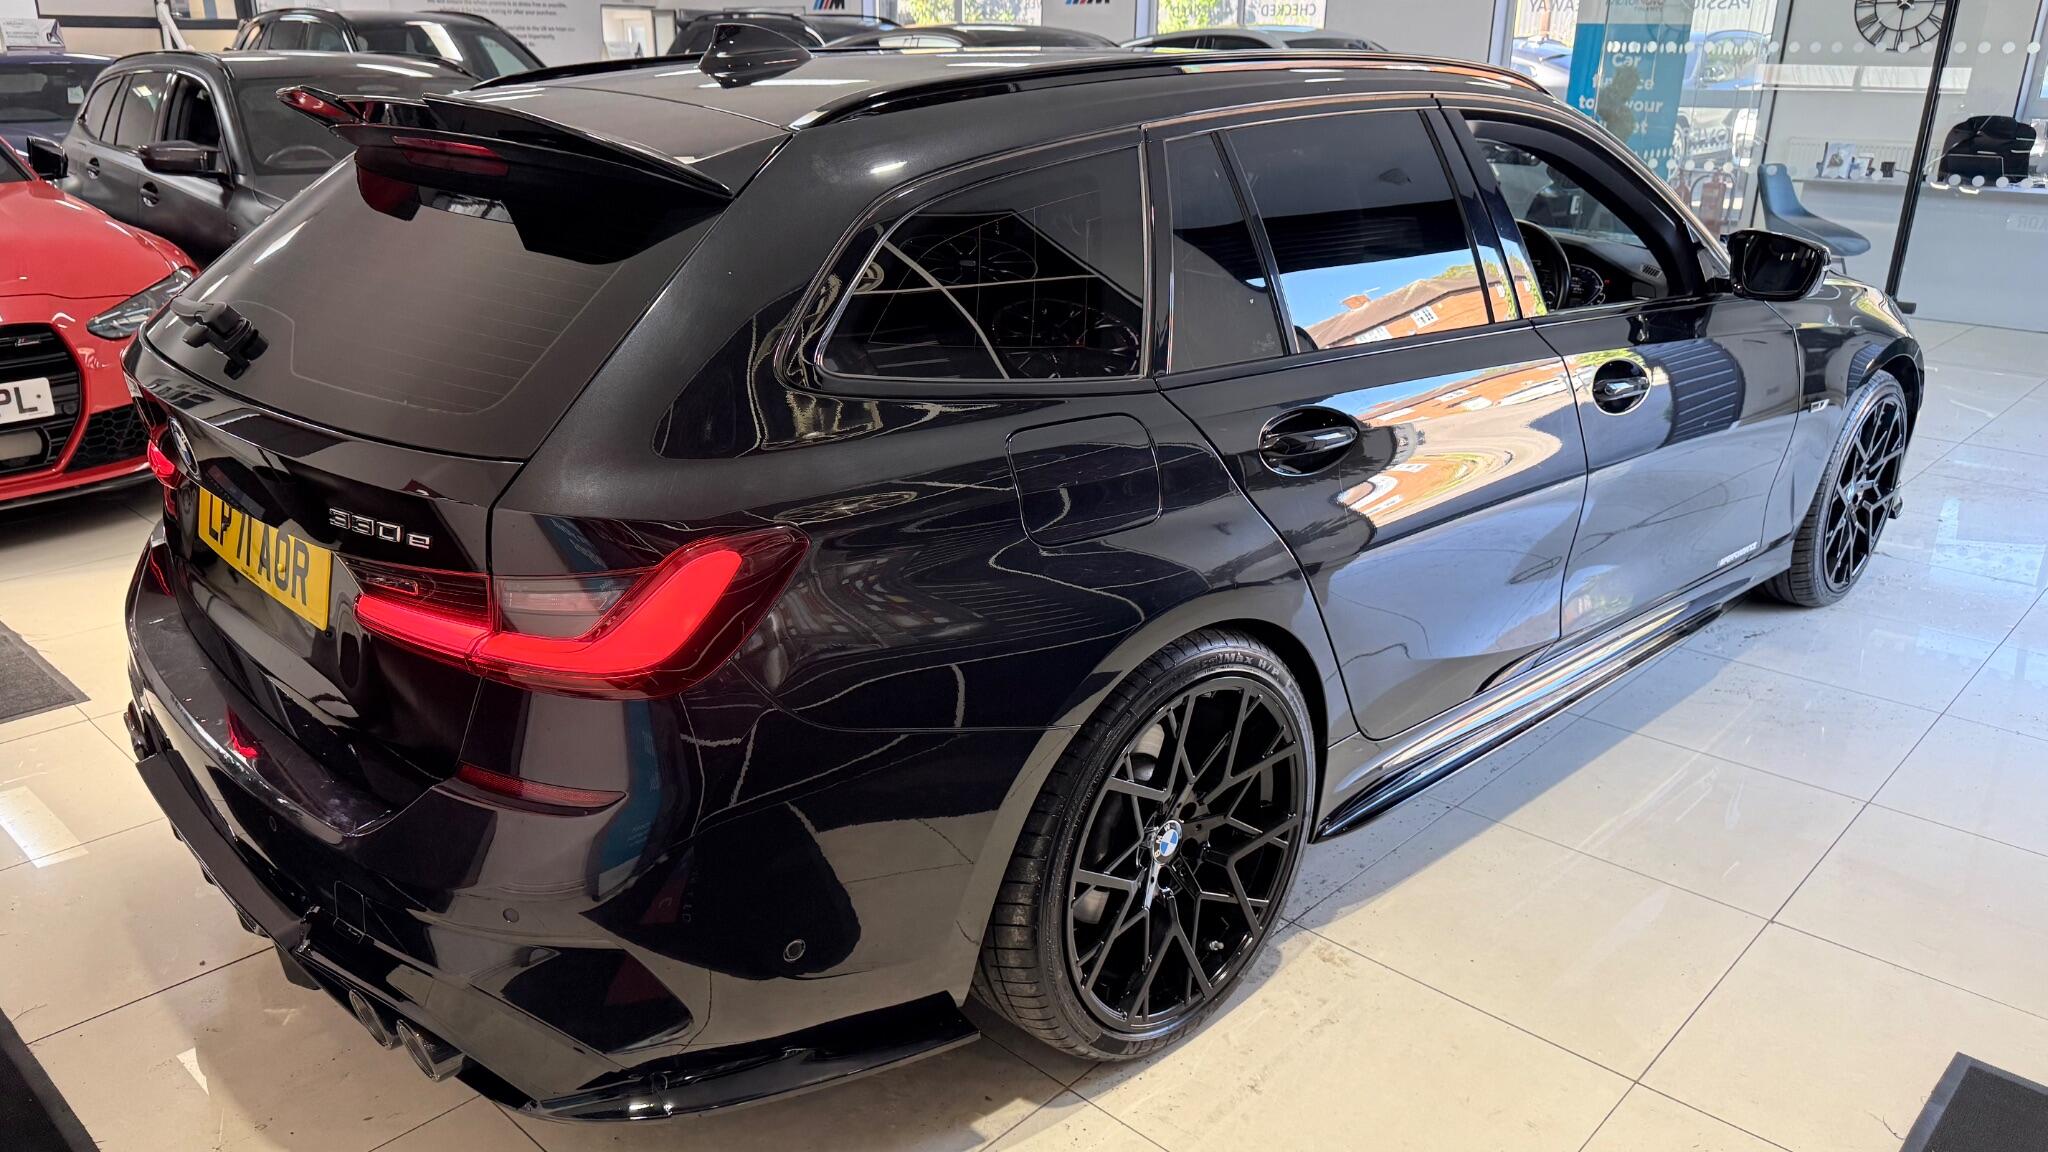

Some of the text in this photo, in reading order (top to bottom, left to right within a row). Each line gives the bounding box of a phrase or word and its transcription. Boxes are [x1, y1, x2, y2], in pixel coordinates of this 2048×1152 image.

[1612, 53, 1641, 67] Car
[1592, 73, 1655, 90] fnce
[1579, 95, 1595, 109] to
[257, 523, 310, 607] AOR
